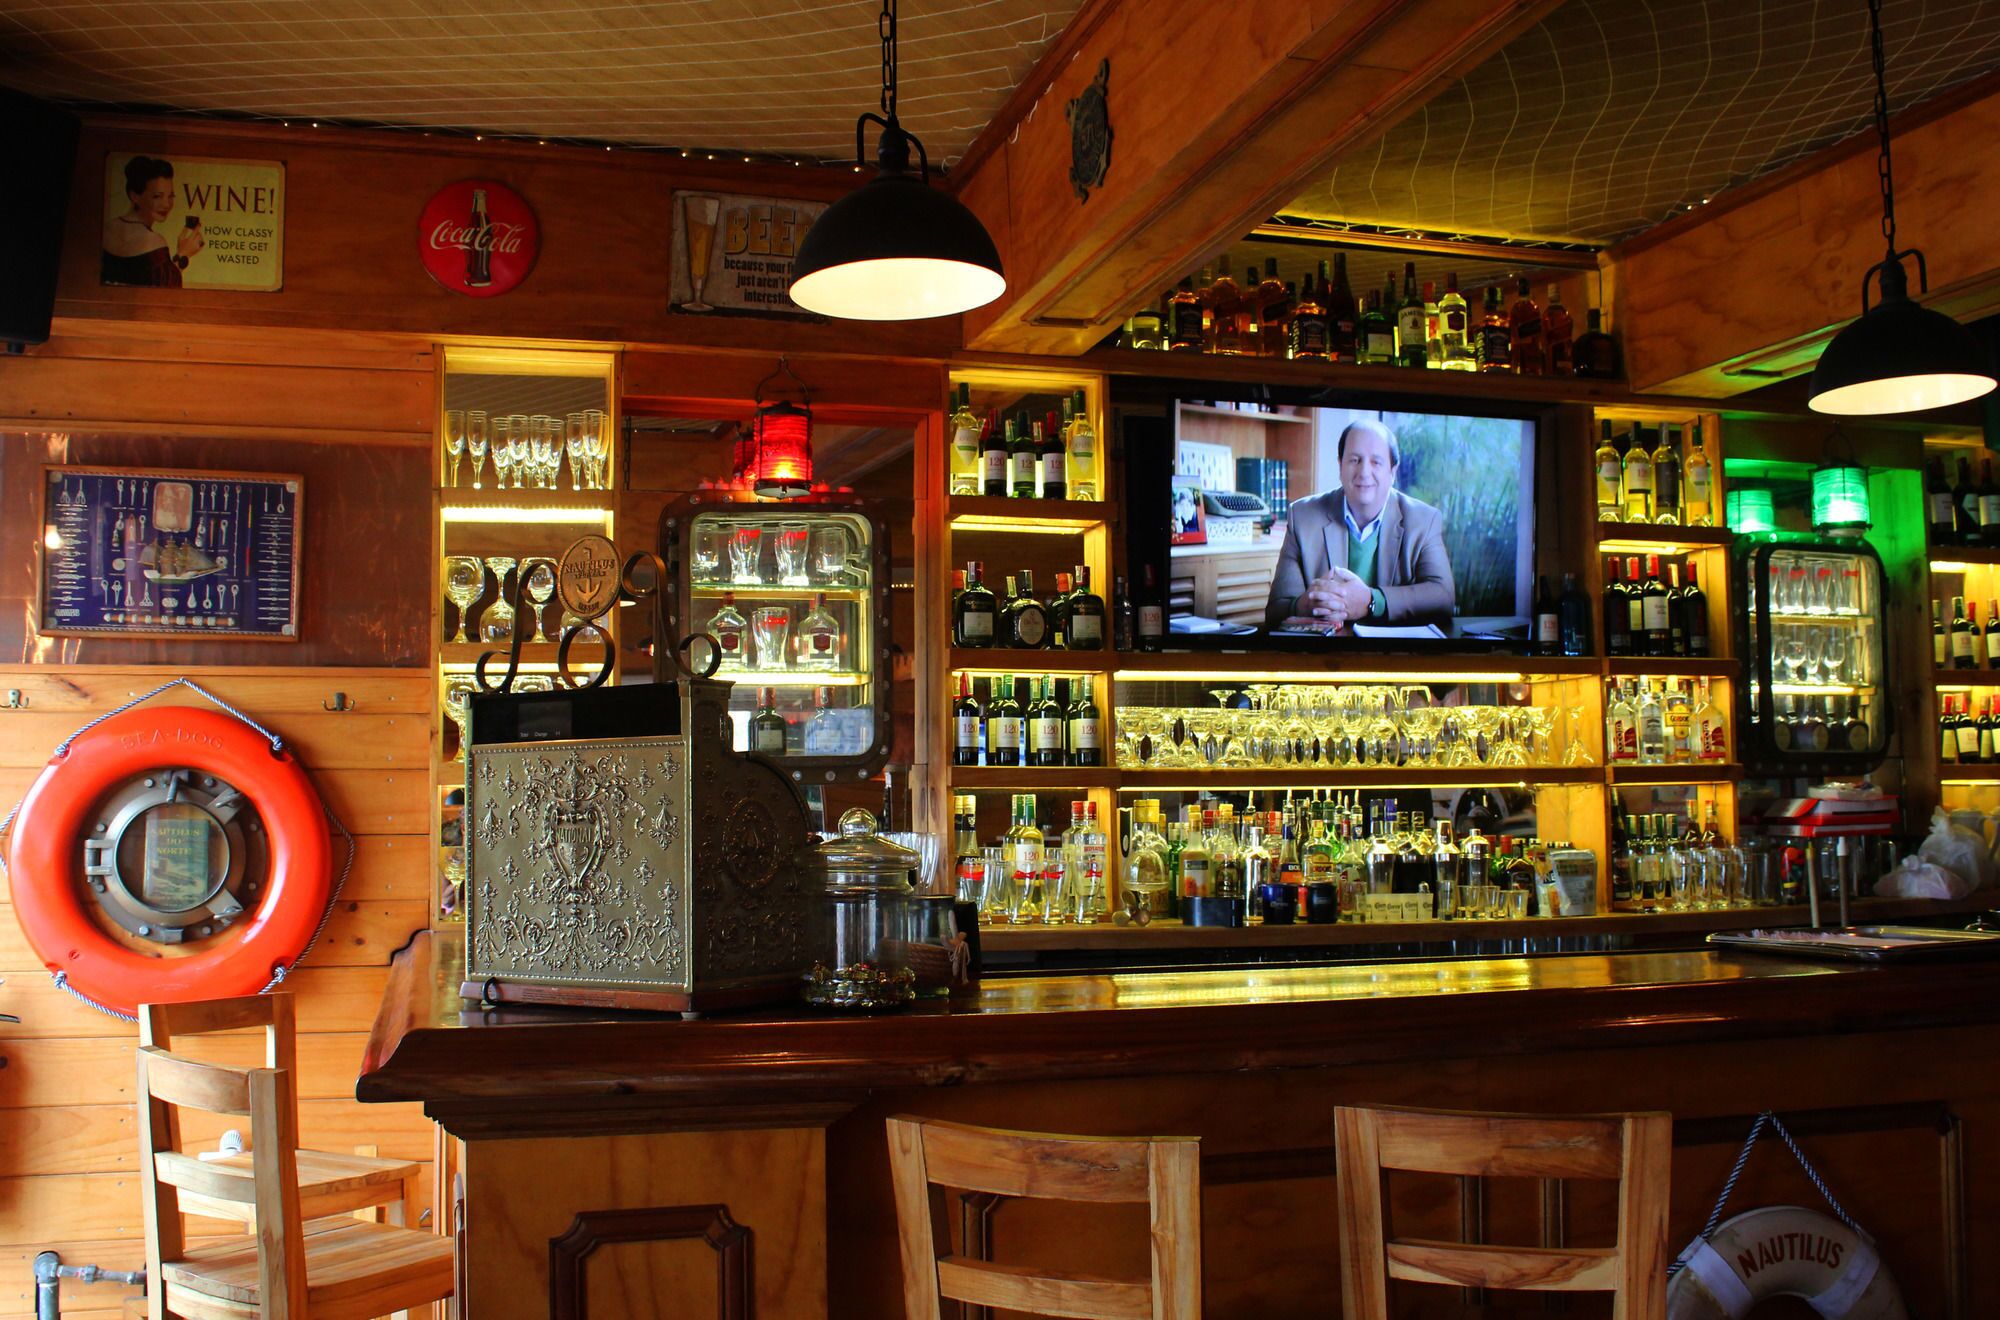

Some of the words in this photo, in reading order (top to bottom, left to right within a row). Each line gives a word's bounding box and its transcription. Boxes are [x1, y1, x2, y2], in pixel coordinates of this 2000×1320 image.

[183, 183, 275, 214] WINE!
[204, 226, 232, 236] HOW
[235, 227, 273, 238] CLASSY
[430, 219, 525, 253] Coca-Cola
[208, 239, 245, 250] PEOPLE
[249, 241, 268, 251] GET
[217, 254, 260, 265] WASTED
[724, 256, 763, 272] because
[766, 260, 785, 275] your
[736, 272, 755, 288] just
[757, 274, 785, 289] aren't
[744, 289, 795, 308] interesti
[564, 559, 615, 574] NAUTILUS
[963, 723, 977, 733] 120
[1004, 723, 1018, 733] 120
[1043, 724, 1058, 735] 120
[1082, 724, 1097, 735] 120
[1024, 851, 1039, 861] 120
[1737, 1232, 1844, 1279] NAUTILUS
